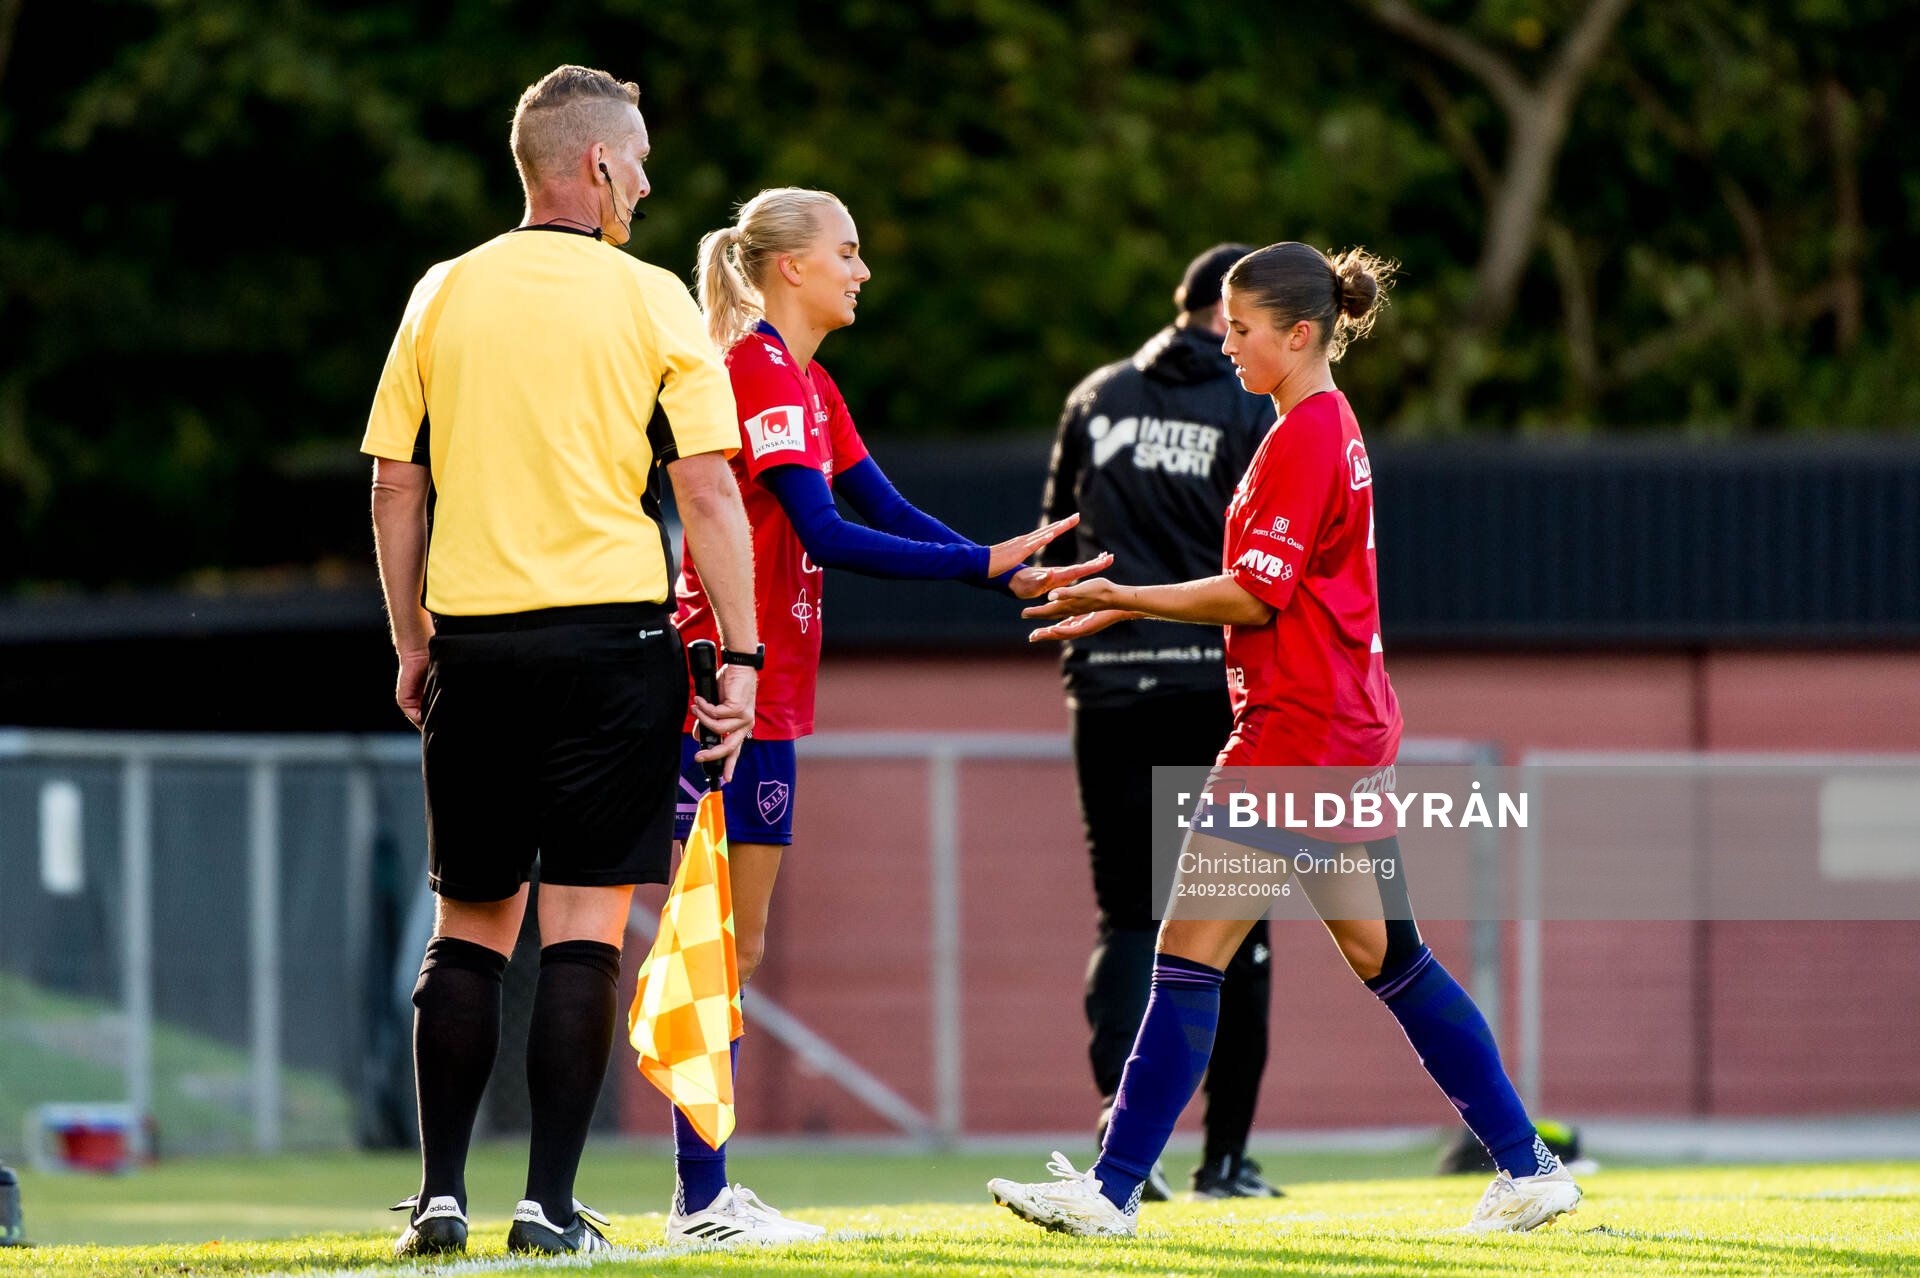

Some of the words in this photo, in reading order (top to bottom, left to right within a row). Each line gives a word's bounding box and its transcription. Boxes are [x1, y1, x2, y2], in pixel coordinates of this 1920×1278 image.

[1138, 416, 1223, 451] INTER
[1133, 442, 1215, 477] SPORT
[1241, 549, 1284, 578] MVB
[429, 1205, 457, 1213] adidas
